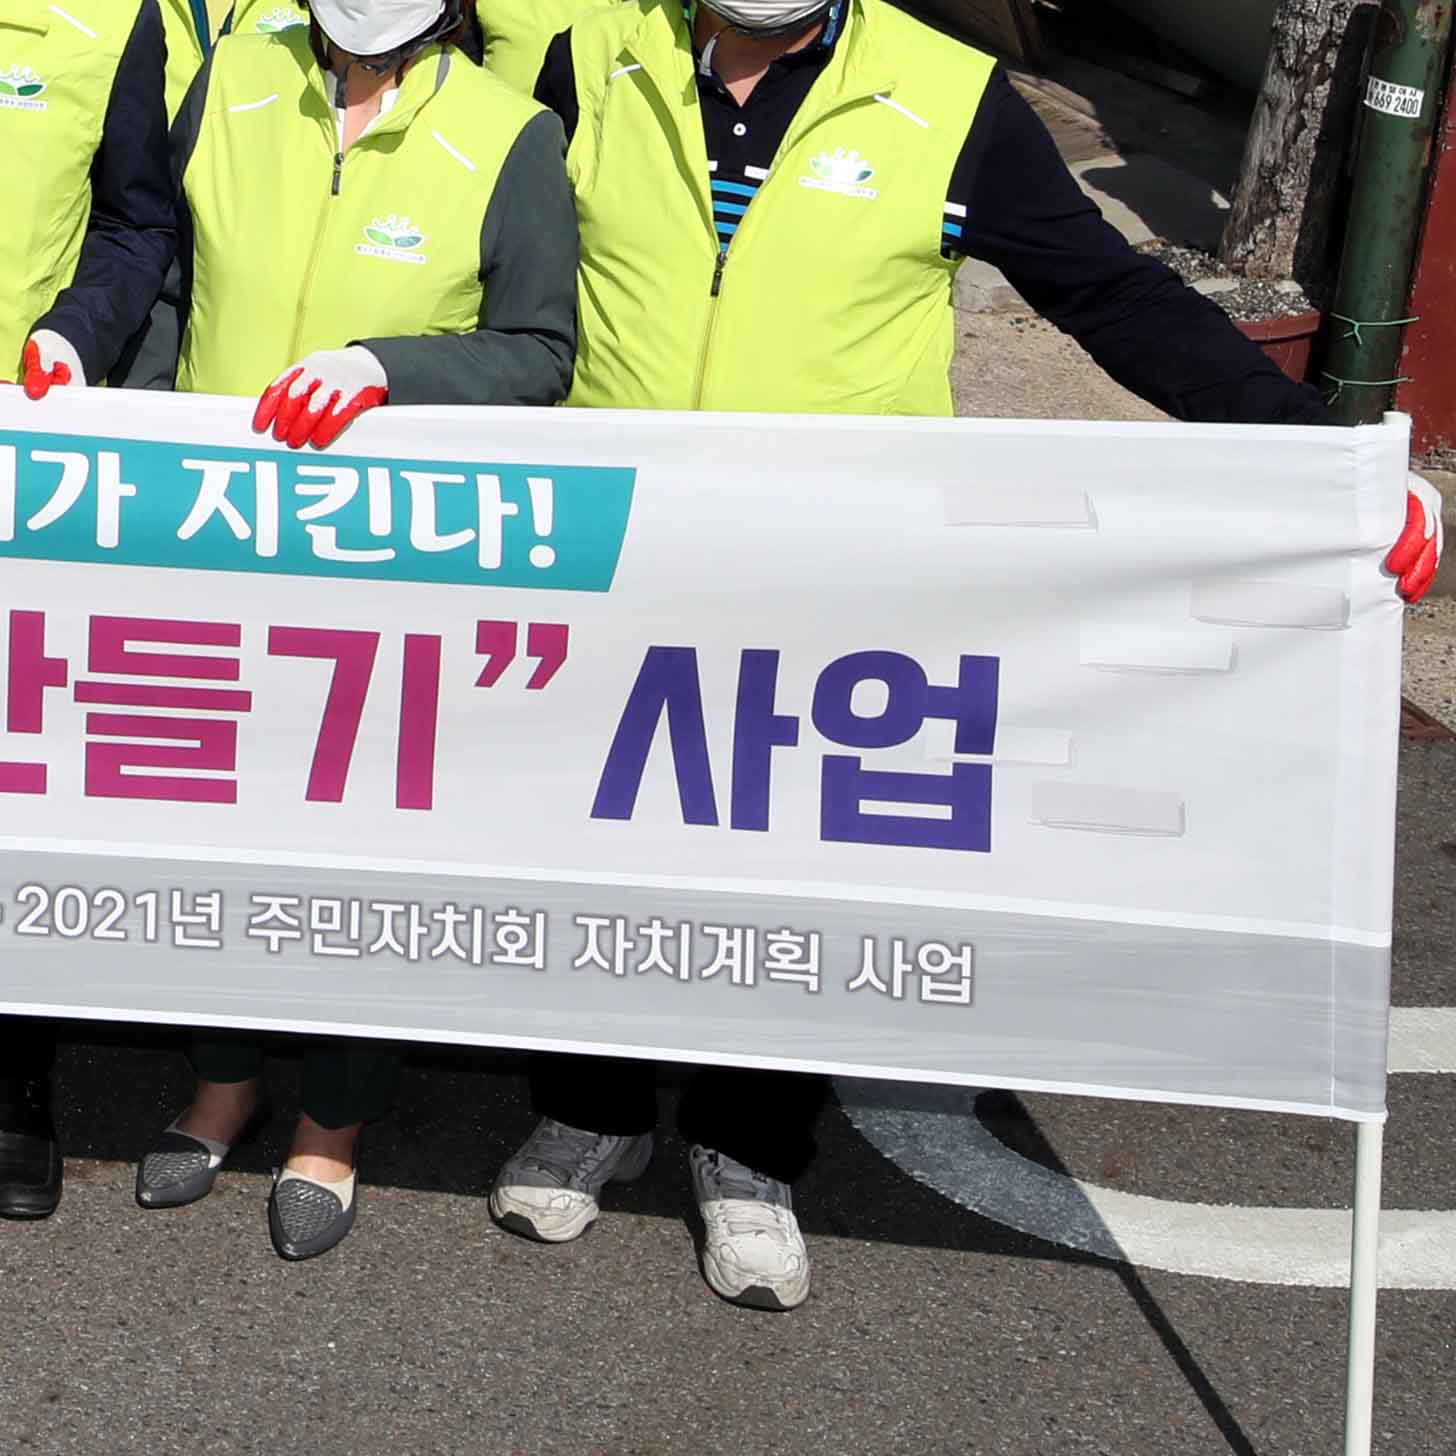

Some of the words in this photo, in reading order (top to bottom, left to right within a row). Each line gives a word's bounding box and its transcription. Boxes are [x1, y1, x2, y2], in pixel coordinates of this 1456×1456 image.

[1393, 96, 1420, 115] 2400
[177, 460, 556, 569] 지킨다!
[590, 645, 1001, 853] 사업
[14, 884, 224, 951] 2021년
[247, 891, 547, 972] 주민자치회
[571, 912, 824, 995] 자치계획
[847, 937, 975, 1008] 사업
